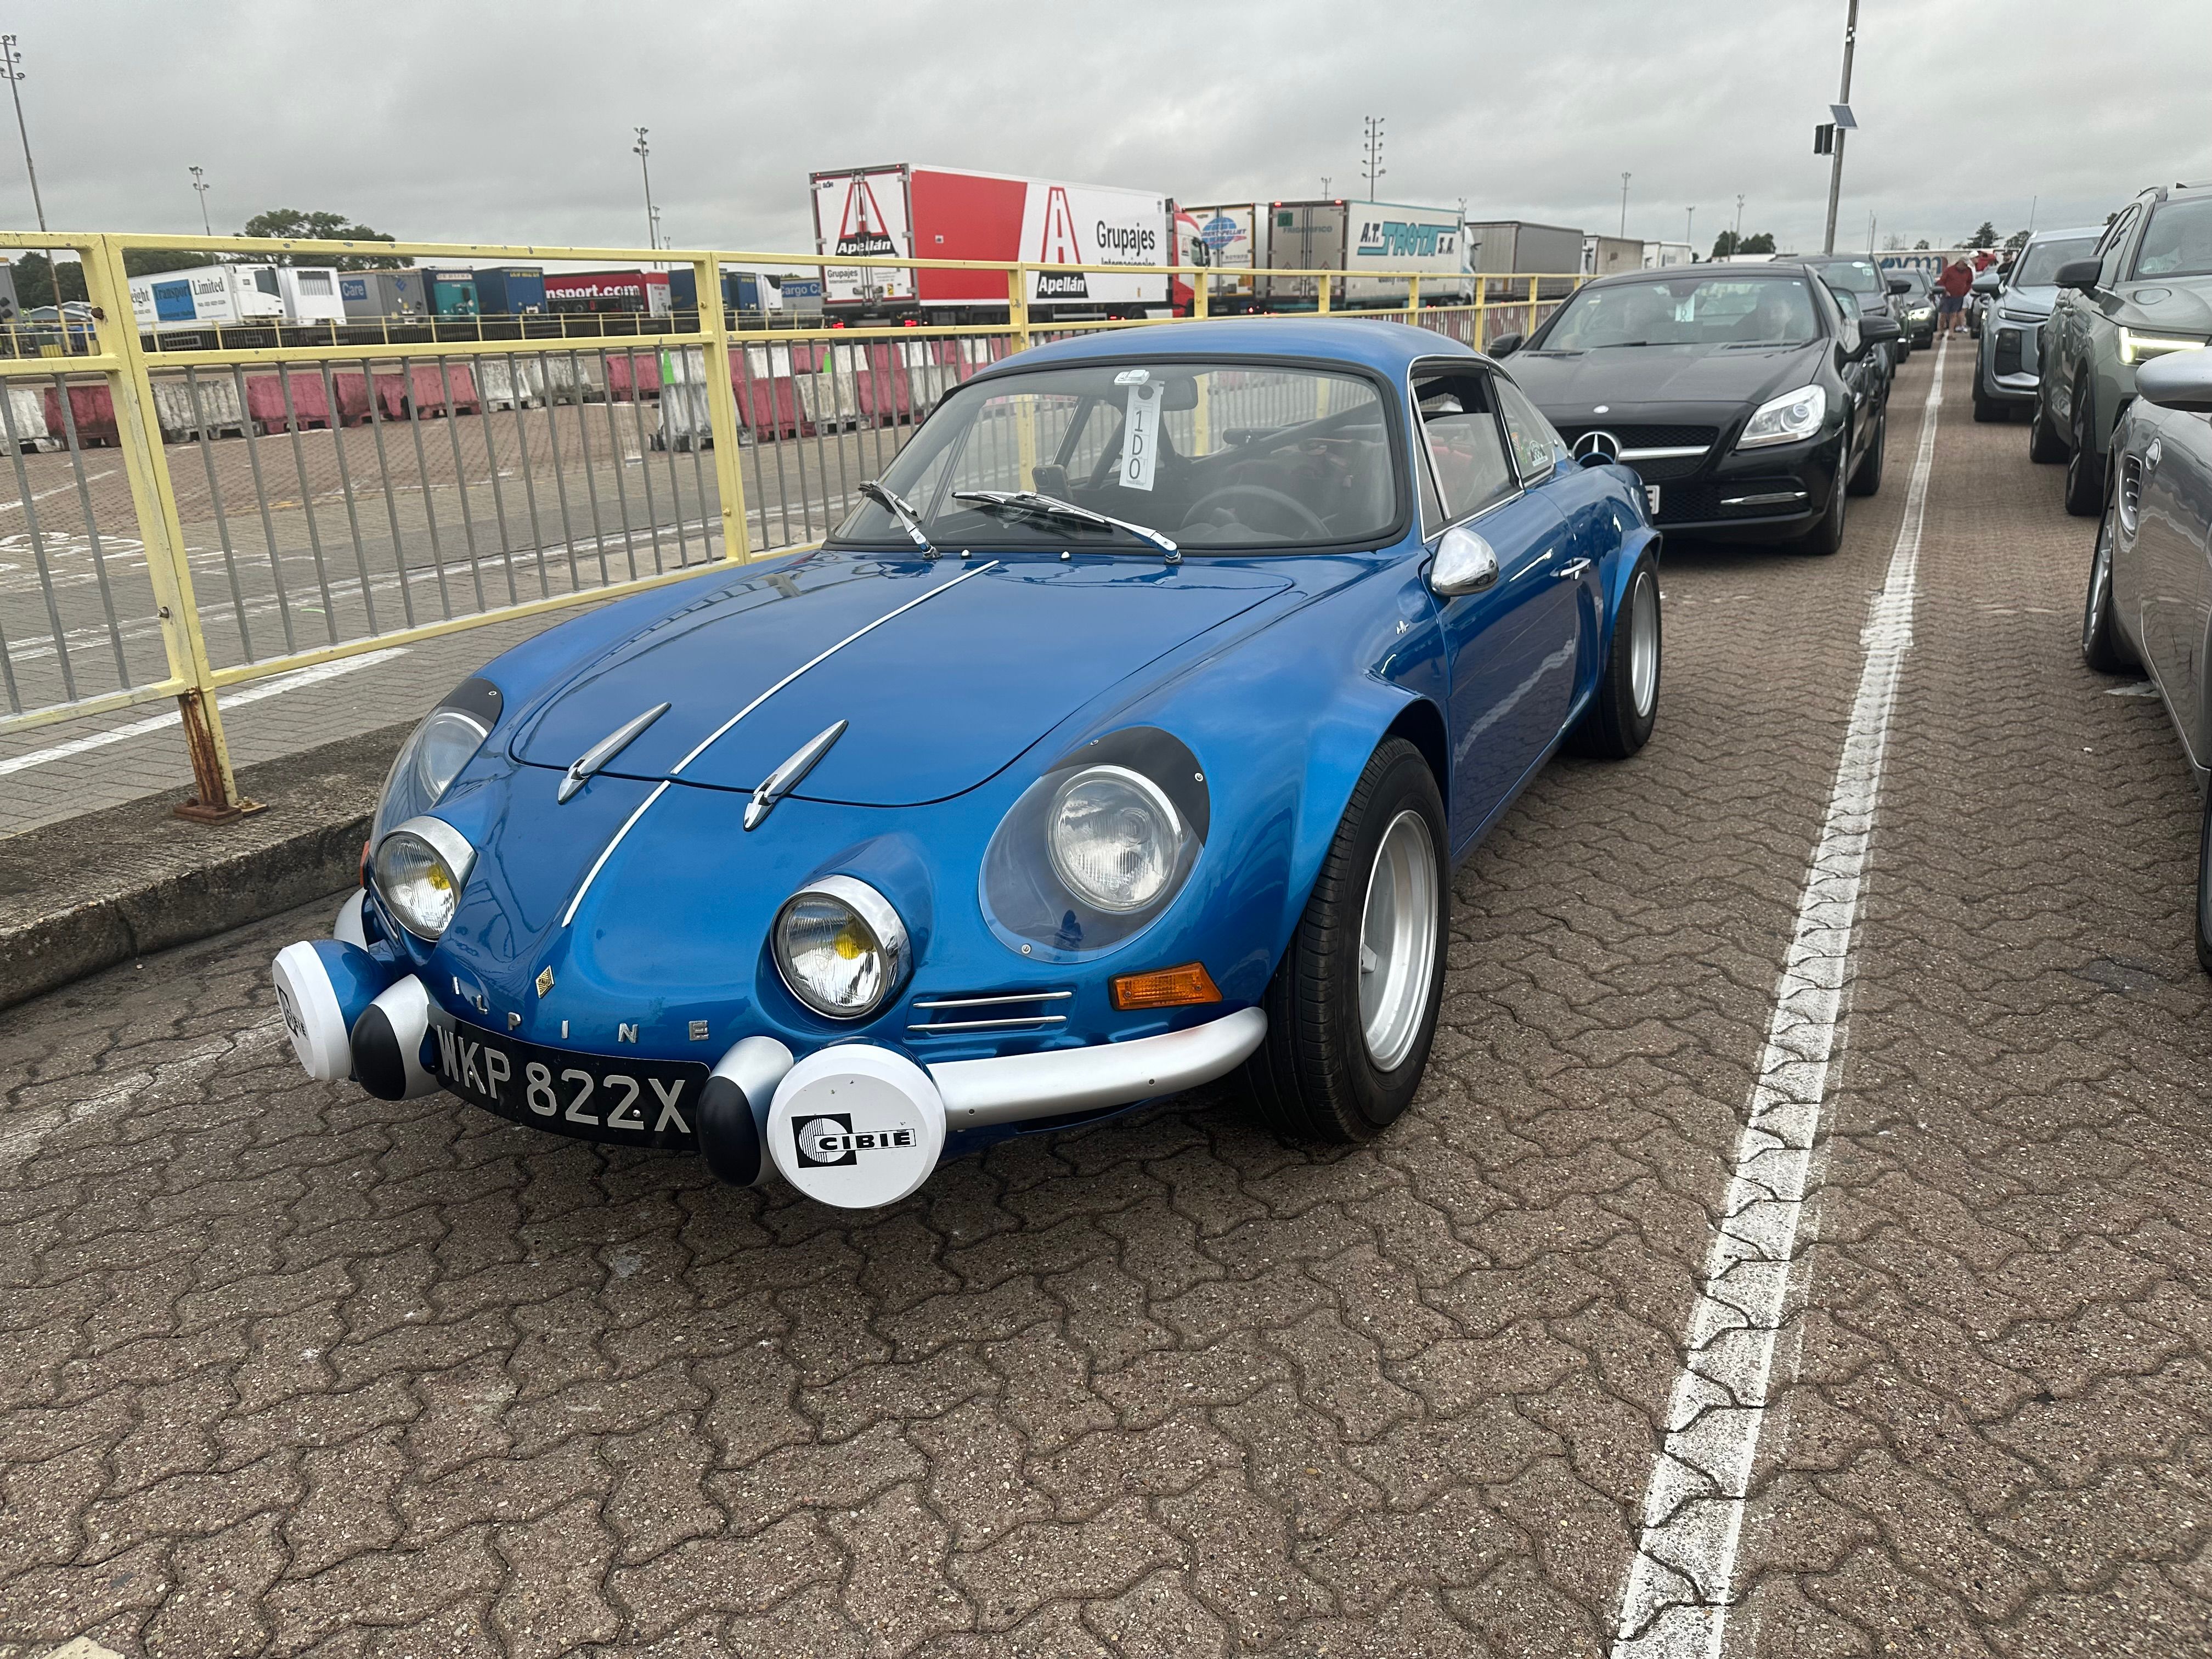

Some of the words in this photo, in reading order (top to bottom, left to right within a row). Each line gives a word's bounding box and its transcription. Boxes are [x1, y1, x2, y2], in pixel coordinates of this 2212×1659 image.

[837, 239, 891, 254] Apellán
[1097, 220, 1155, 257] Grupajes
[827, 269, 858, 279] Grupajes
[152, 284, 191, 302] Transport
[192, 276, 224, 295] Limited
[342, 282, 364, 297] Care
[1039, 276, 1085, 295] Apellán
[437, 1025, 511, 1099] WKP
[526, 1062, 691, 1133] 822X
